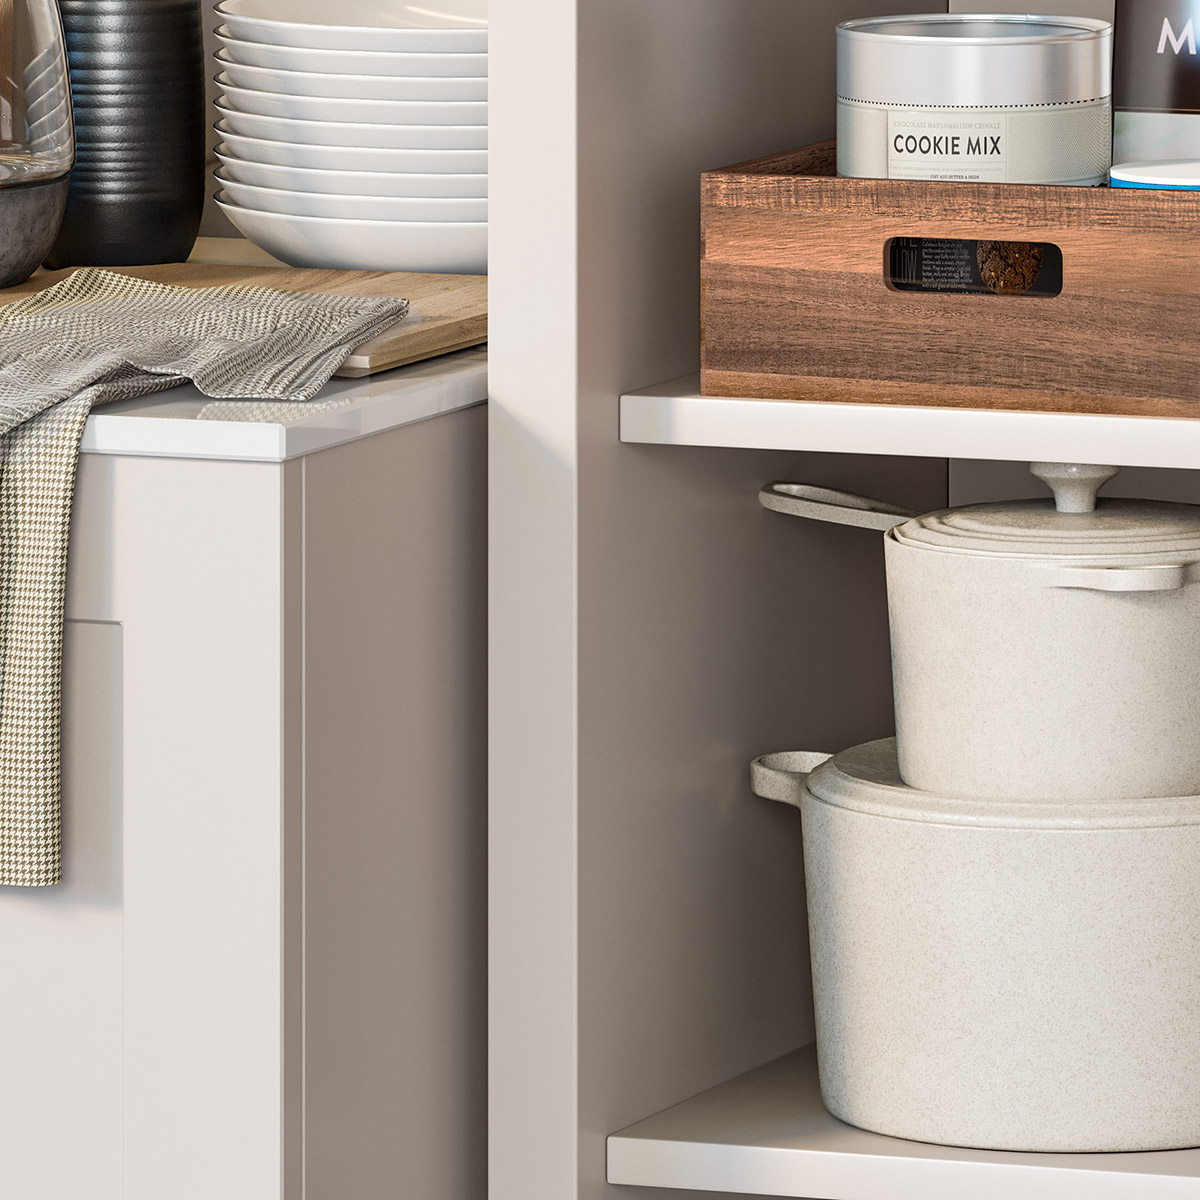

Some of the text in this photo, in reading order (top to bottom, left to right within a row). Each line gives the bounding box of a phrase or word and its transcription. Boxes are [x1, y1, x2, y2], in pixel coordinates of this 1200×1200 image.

[893, 120, 1001, 130] CHOCOLATE MARSHMALLOW CRINKLE
[894, 134, 1001, 155] COOKIE MIX
